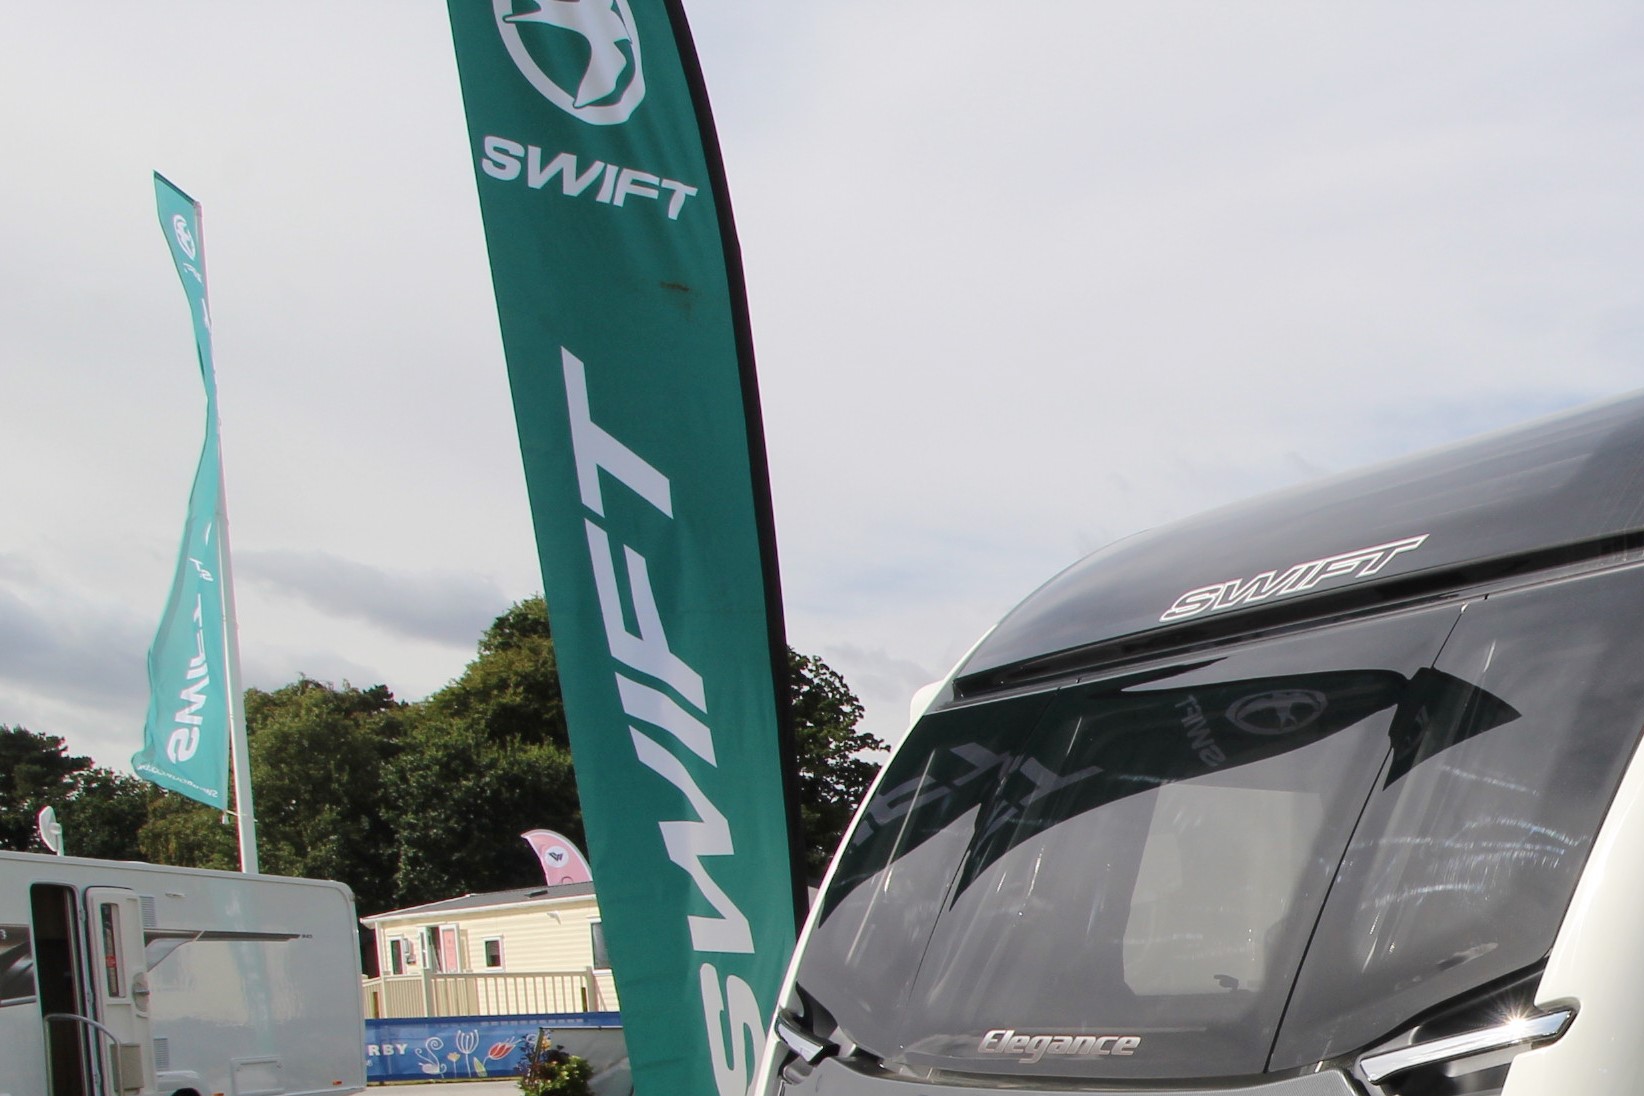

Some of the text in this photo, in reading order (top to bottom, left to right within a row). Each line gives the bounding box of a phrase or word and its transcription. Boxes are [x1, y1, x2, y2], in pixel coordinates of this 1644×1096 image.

[481, 135, 698, 220] SWIFT
[1158, 533, 1430, 622] SWIFT
[368, 1043, 408, 1057] RBY
[978, 1029, 1142, 1064] Elegance
